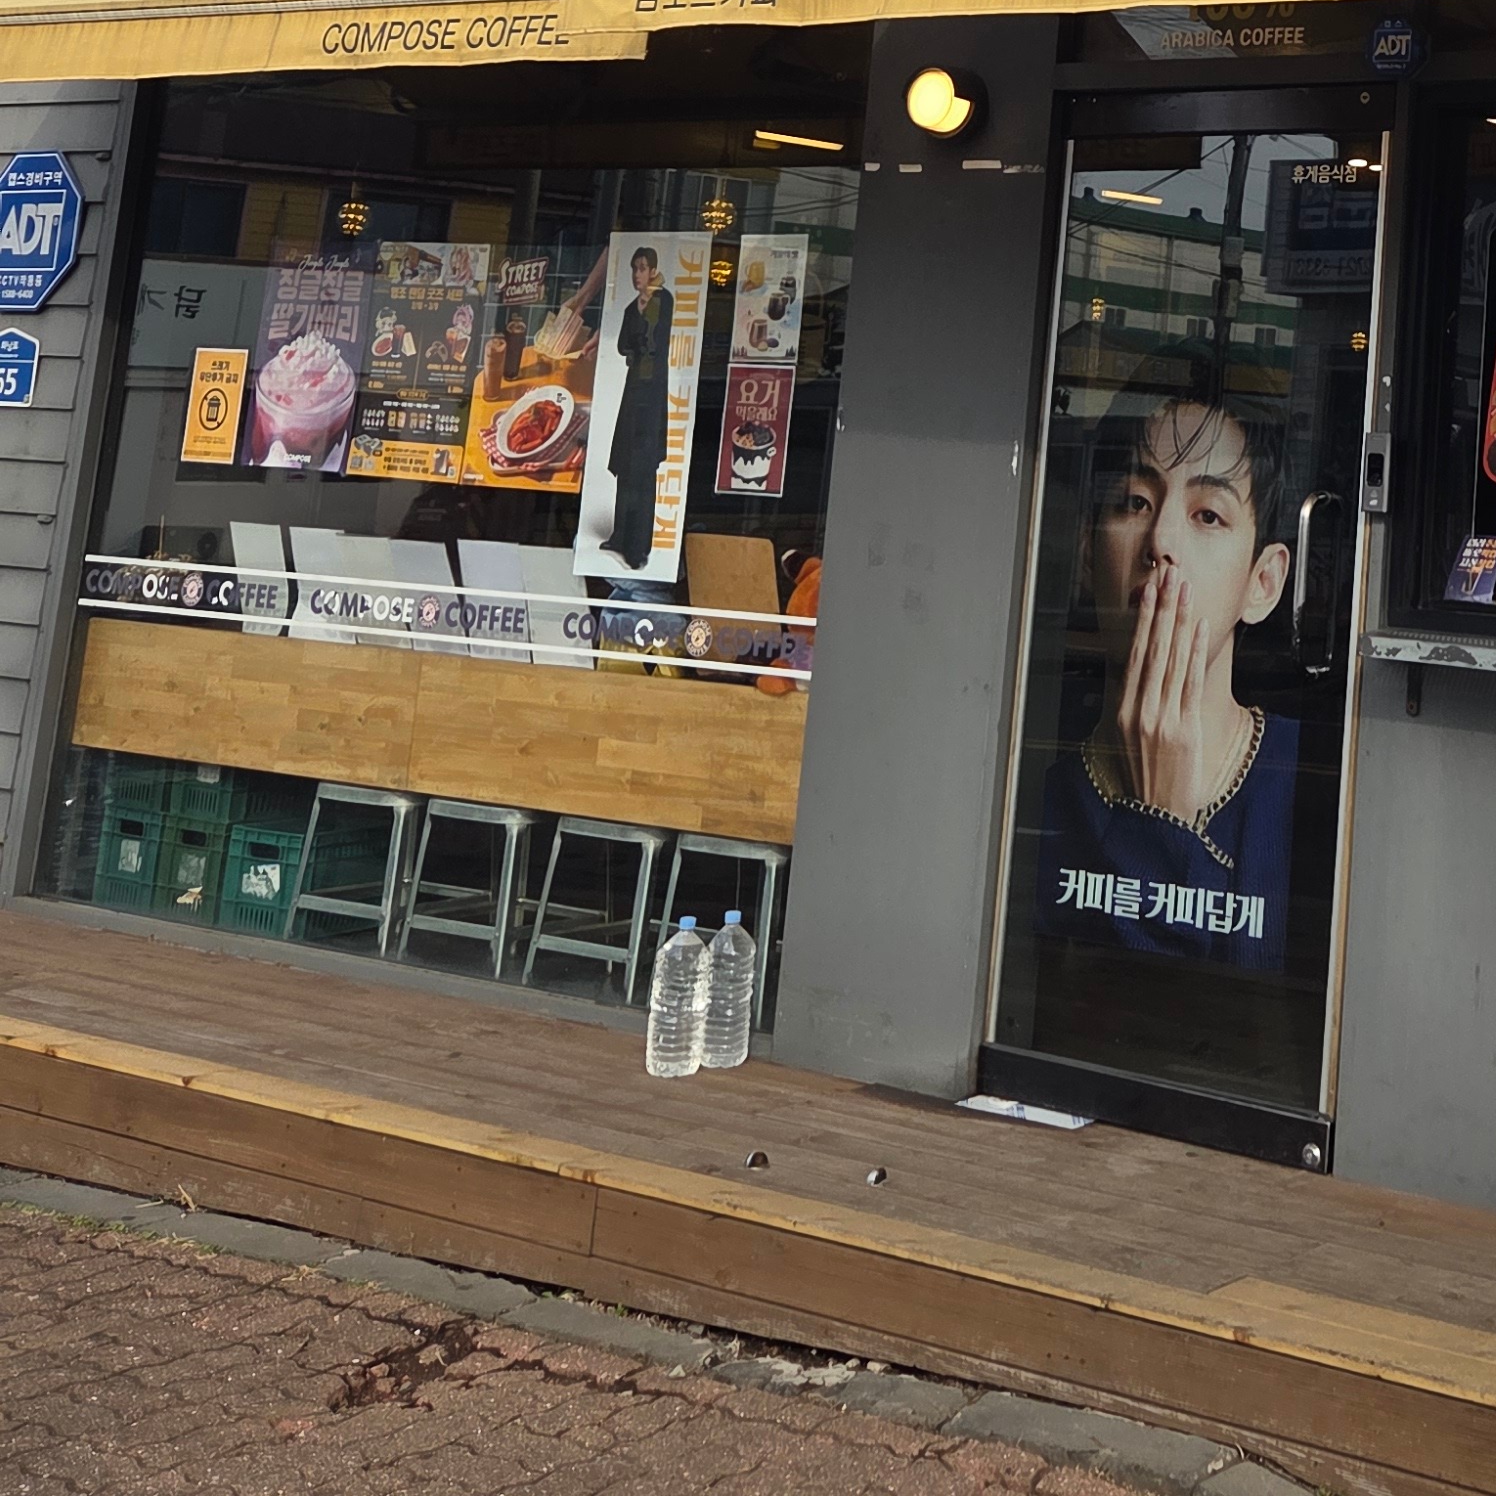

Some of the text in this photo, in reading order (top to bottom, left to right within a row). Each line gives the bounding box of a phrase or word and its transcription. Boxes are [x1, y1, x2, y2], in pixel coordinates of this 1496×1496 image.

[321, 16, 457, 55] COMPOSE
[1160, 26, 1305, 49] ARABICA COFFEE
[1373, 35, 1412, 57] ADT
[1291, 164, 1357, 184] 휴게음식점
[498, 259, 547, 290] STREET
[737, 379, 781, 408] 요거
[310, 588, 525, 636] COMPOSE COFFEE
[1054, 865, 1264, 941] 커피를 커피답게
